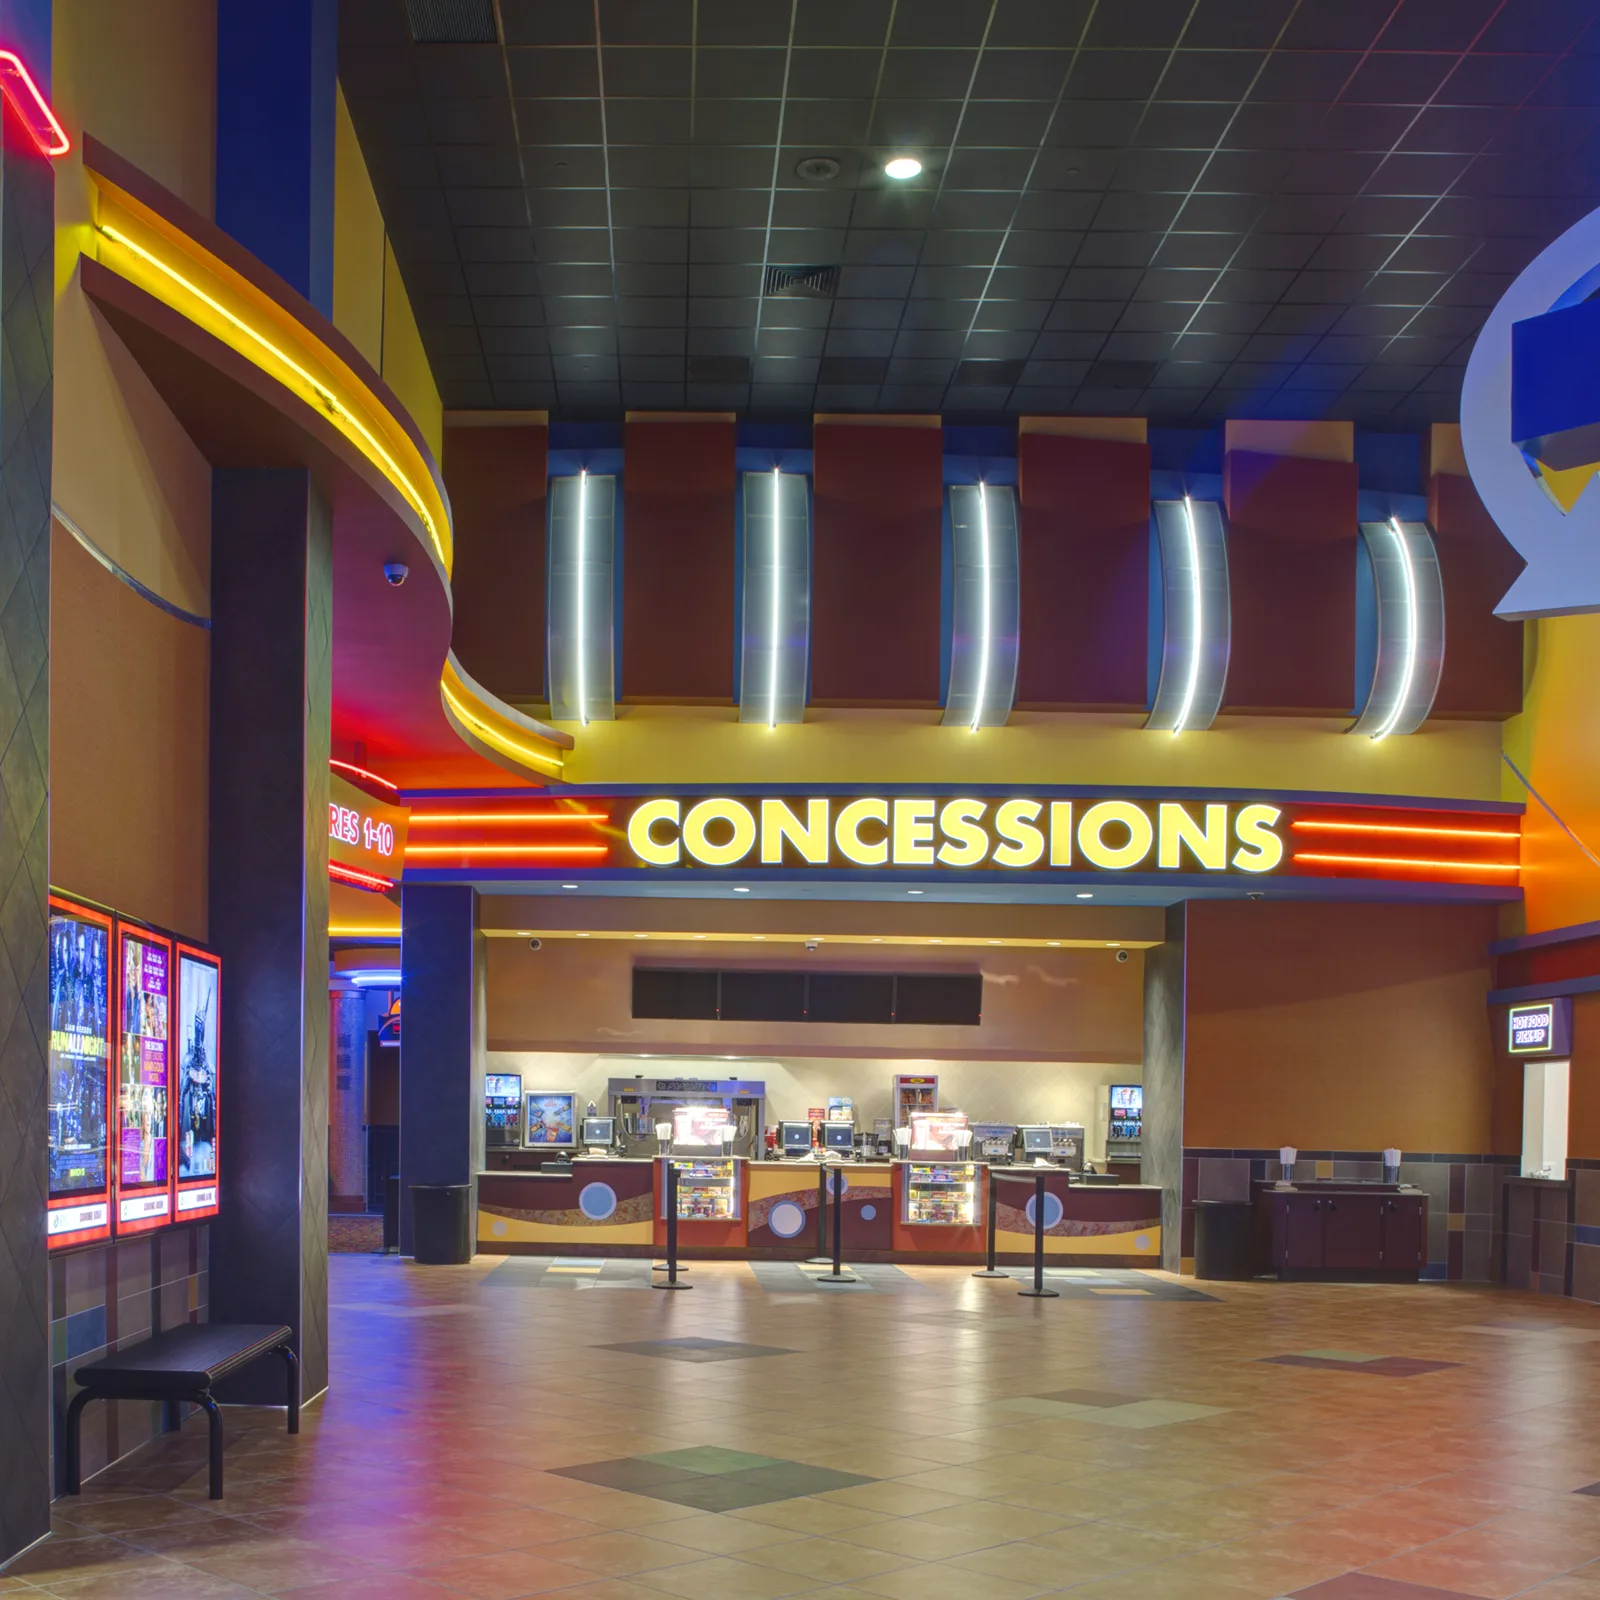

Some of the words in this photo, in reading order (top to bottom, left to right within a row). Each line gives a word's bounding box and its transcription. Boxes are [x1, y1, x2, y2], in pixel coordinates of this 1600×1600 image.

[364, 816, 394, 856] 1-10
[627, 797, 1284, 872] CONCESSIONS
[1512, 1016, 1527, 1030] HOT
[1527, 1013, 1549, 1028] FOOD
